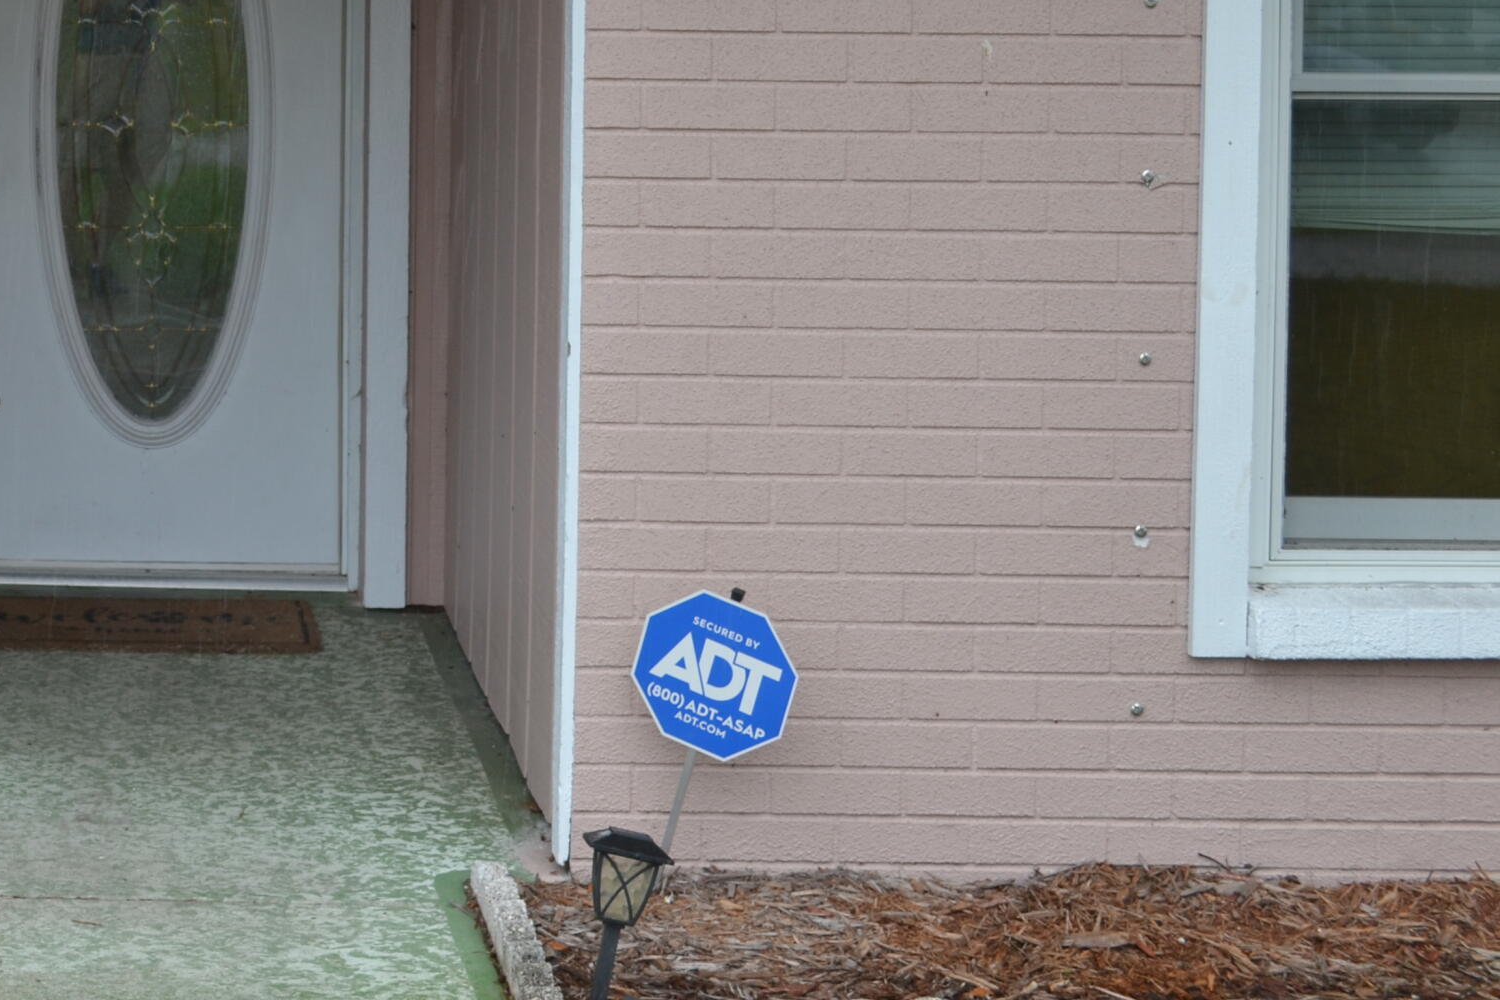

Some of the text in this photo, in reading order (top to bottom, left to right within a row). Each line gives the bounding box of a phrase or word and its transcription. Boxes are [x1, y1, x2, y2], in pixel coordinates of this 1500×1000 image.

[692, 616, 760, 649] SECURED BY
[649, 632, 783, 716] ADT
[647, 682, 765, 740] (800) ADT-ASAP
[674, 711, 727, 739] ADT.COM
